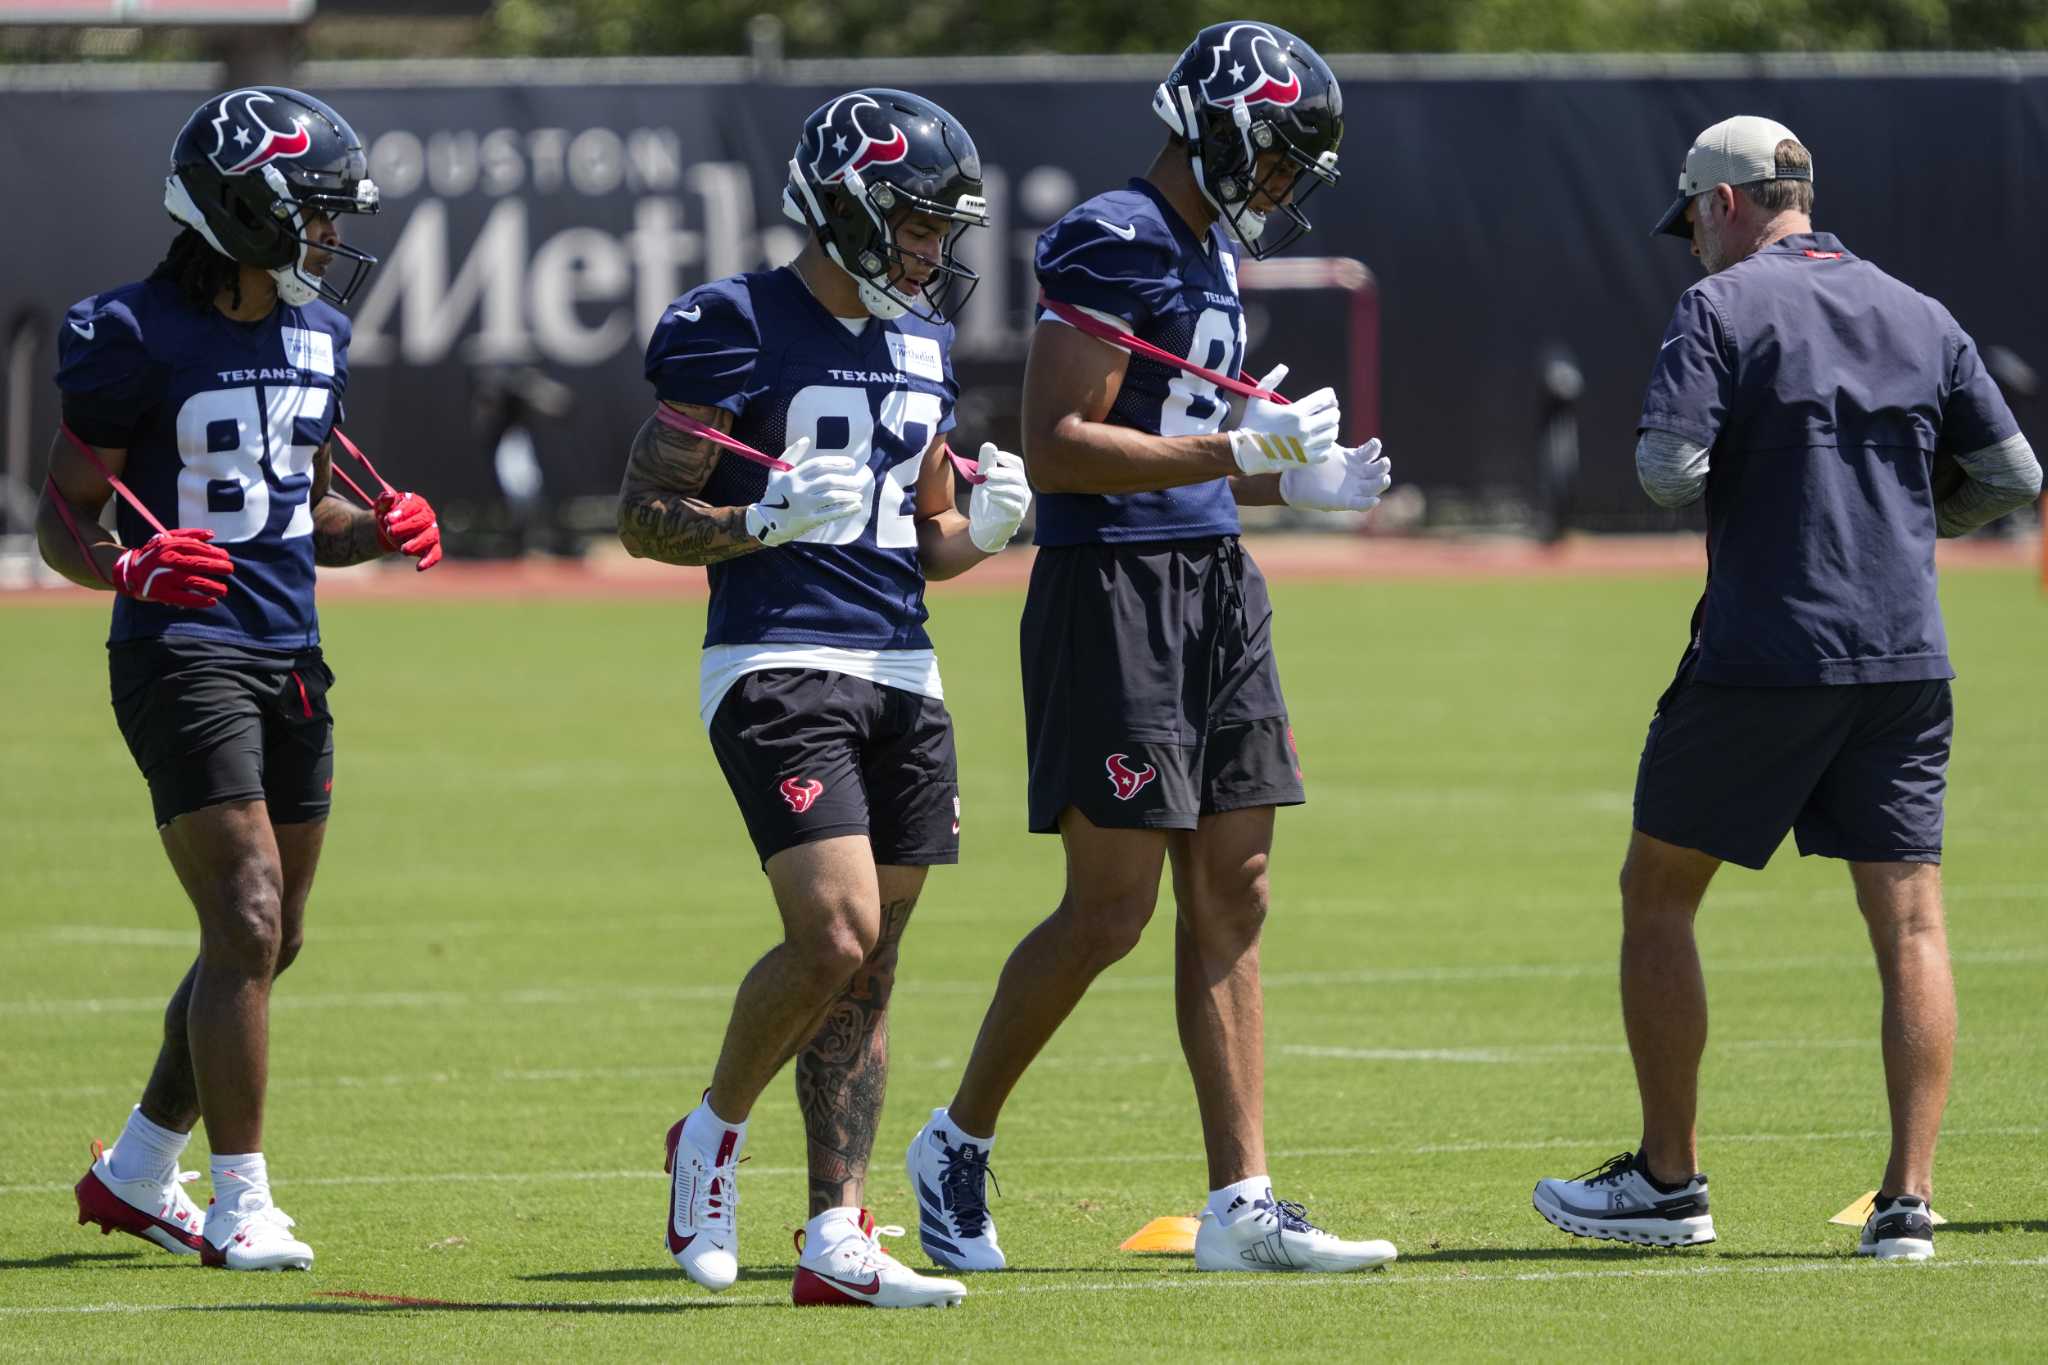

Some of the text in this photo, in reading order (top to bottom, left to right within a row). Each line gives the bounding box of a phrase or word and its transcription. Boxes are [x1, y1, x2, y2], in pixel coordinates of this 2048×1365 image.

[366, 127, 682, 197] OUSTON
[1203, 291, 1236, 307] TEXANS
[217, 368, 297, 383] TEXANS
[827, 369, 908, 384] TEXANS
[176, 385, 330, 543] 85
[784, 385, 942, 548] 82
